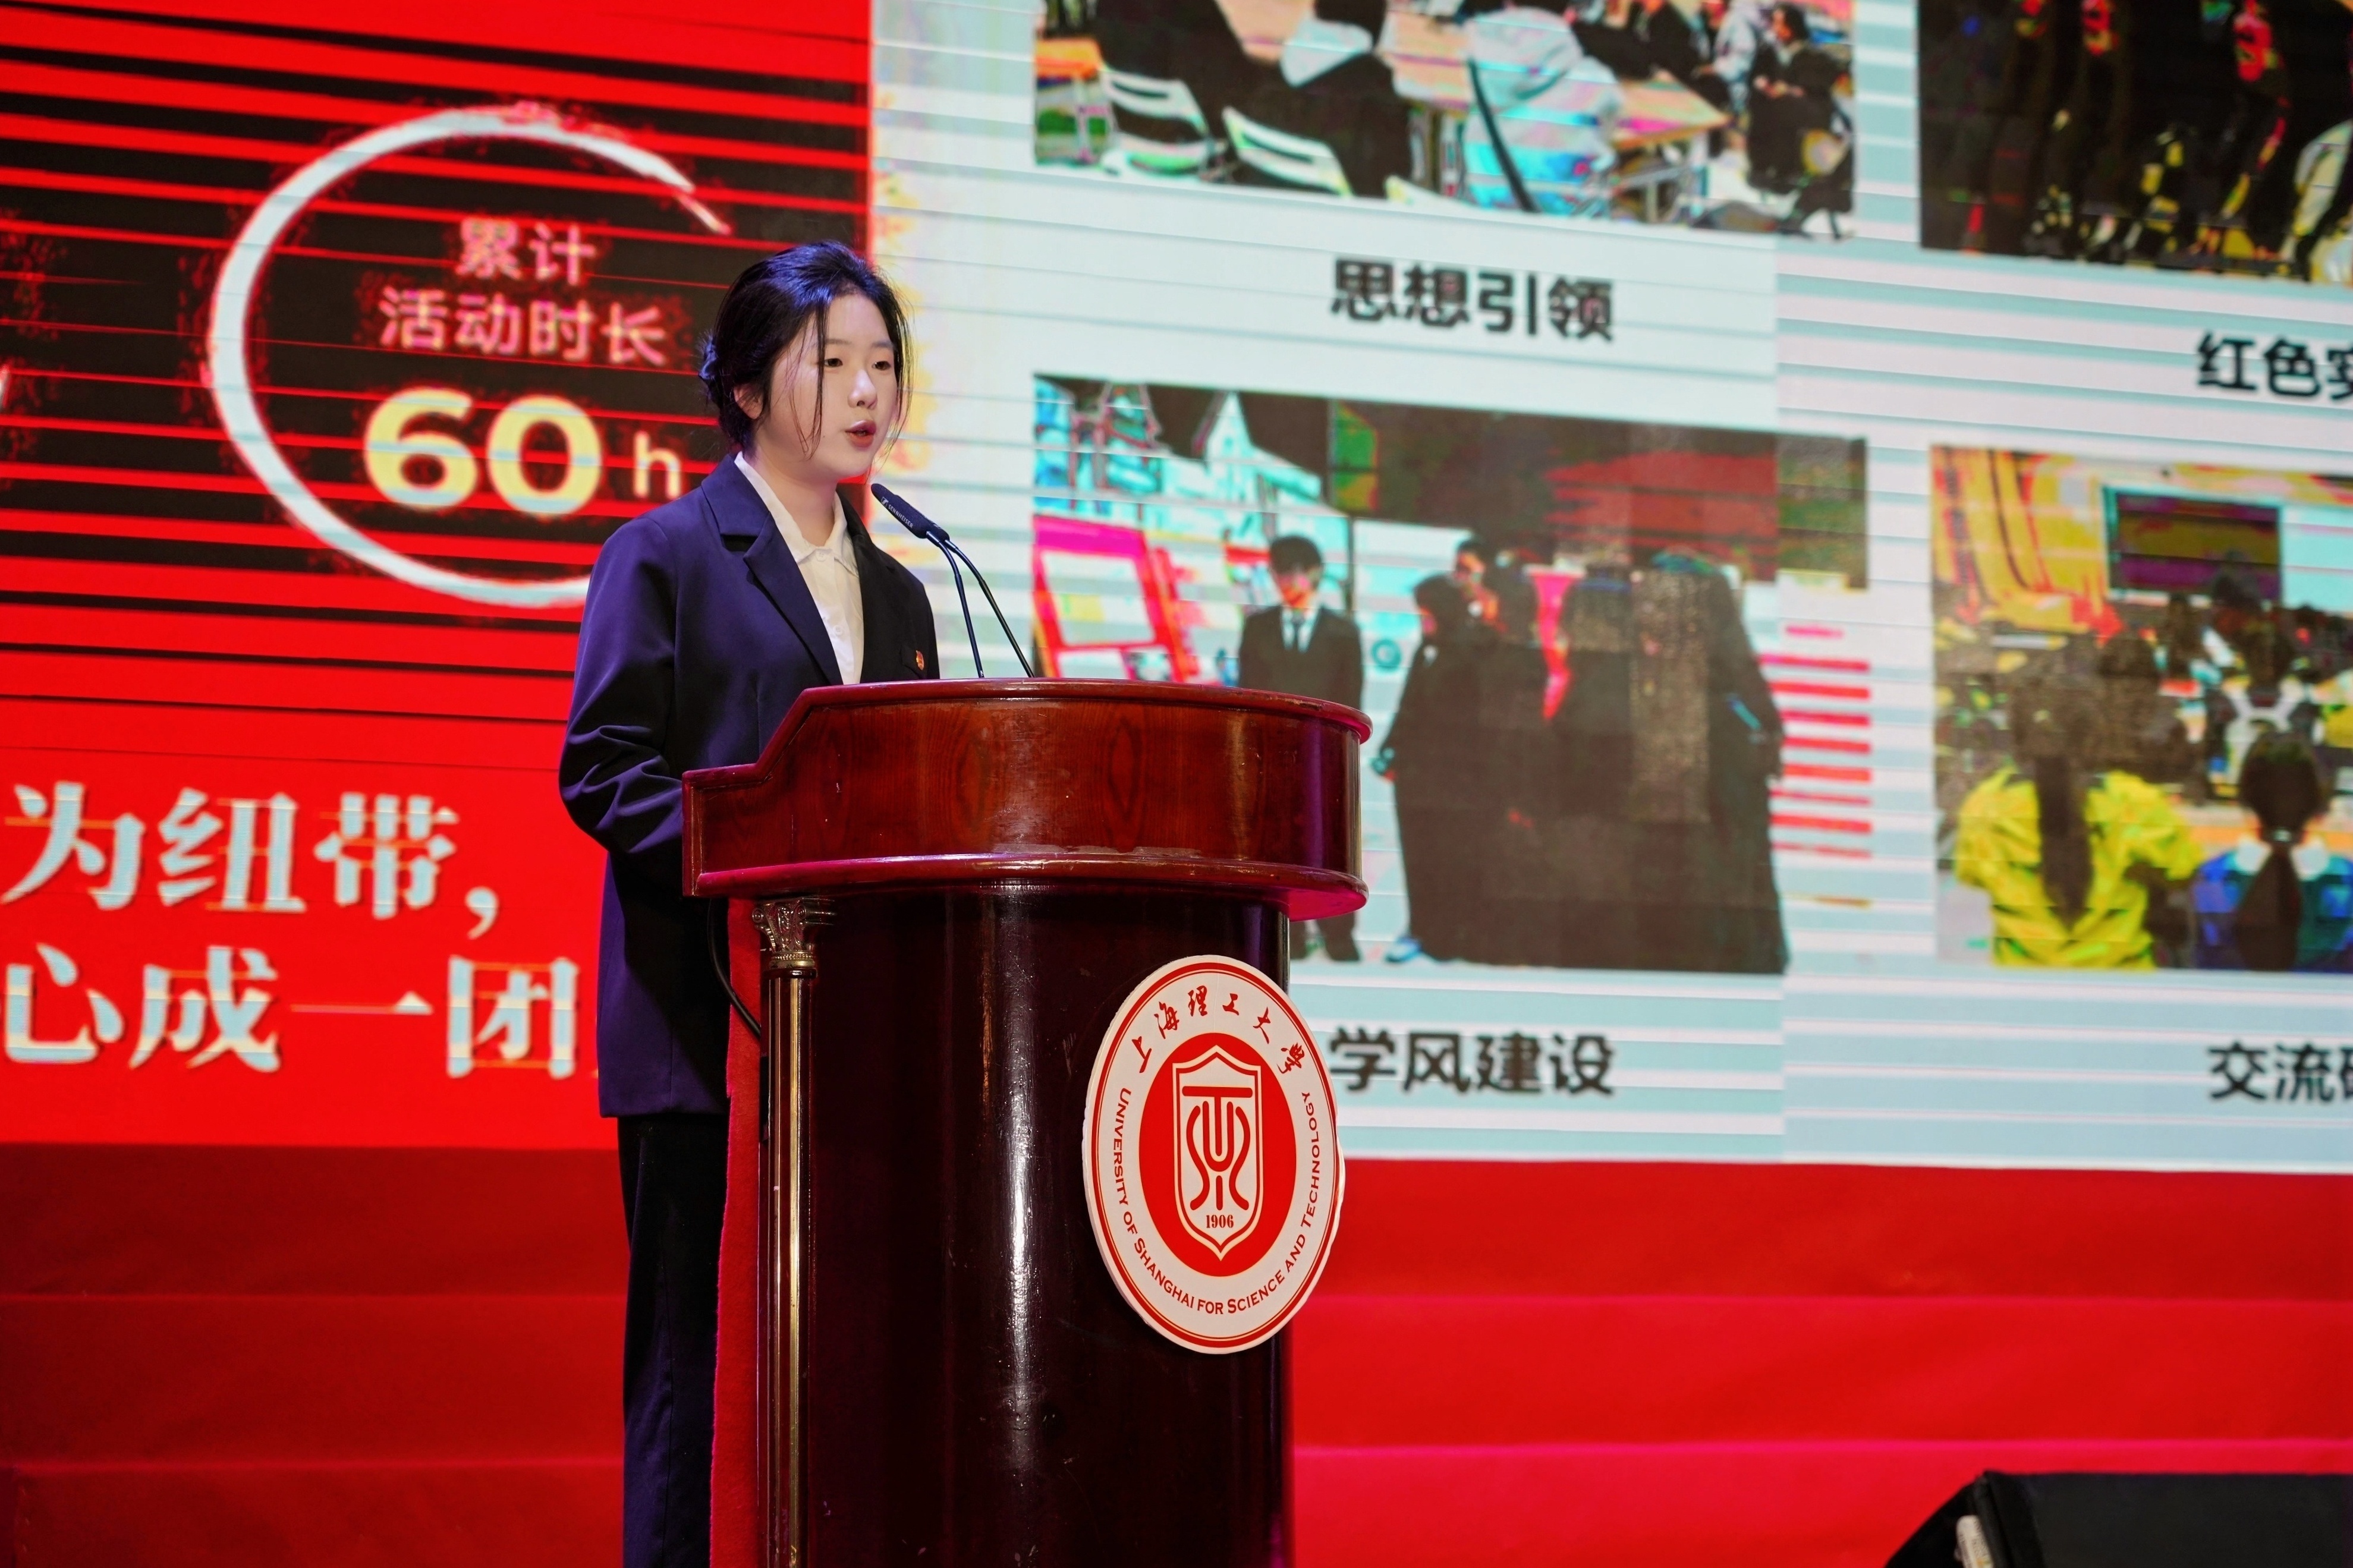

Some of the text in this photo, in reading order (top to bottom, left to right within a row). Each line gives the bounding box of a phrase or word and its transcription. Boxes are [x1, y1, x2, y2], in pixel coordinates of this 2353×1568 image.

[458, 219, 595, 286] 累计
[379, 286, 667, 366] 活动时长
[1332, 259, 1612, 341] 思想引领
[364, 386, 682, 518] 60 h
[888, 504, 914, 528] SENNHEISER
[0, 780, 498, 939] 为纽带，
[4, 943, 578, 1079] 心成一团
[1329, 1027, 1613, 1094] 学风建设
[2209, 1041, 2353, 1101] 交流
[1113, 1088, 1320, 1315] UNIVERSITY OF SHANGHAI FOR SCIENCE AND TECHNOLOGY
[1206, 1214, 1234, 1229] 1906
